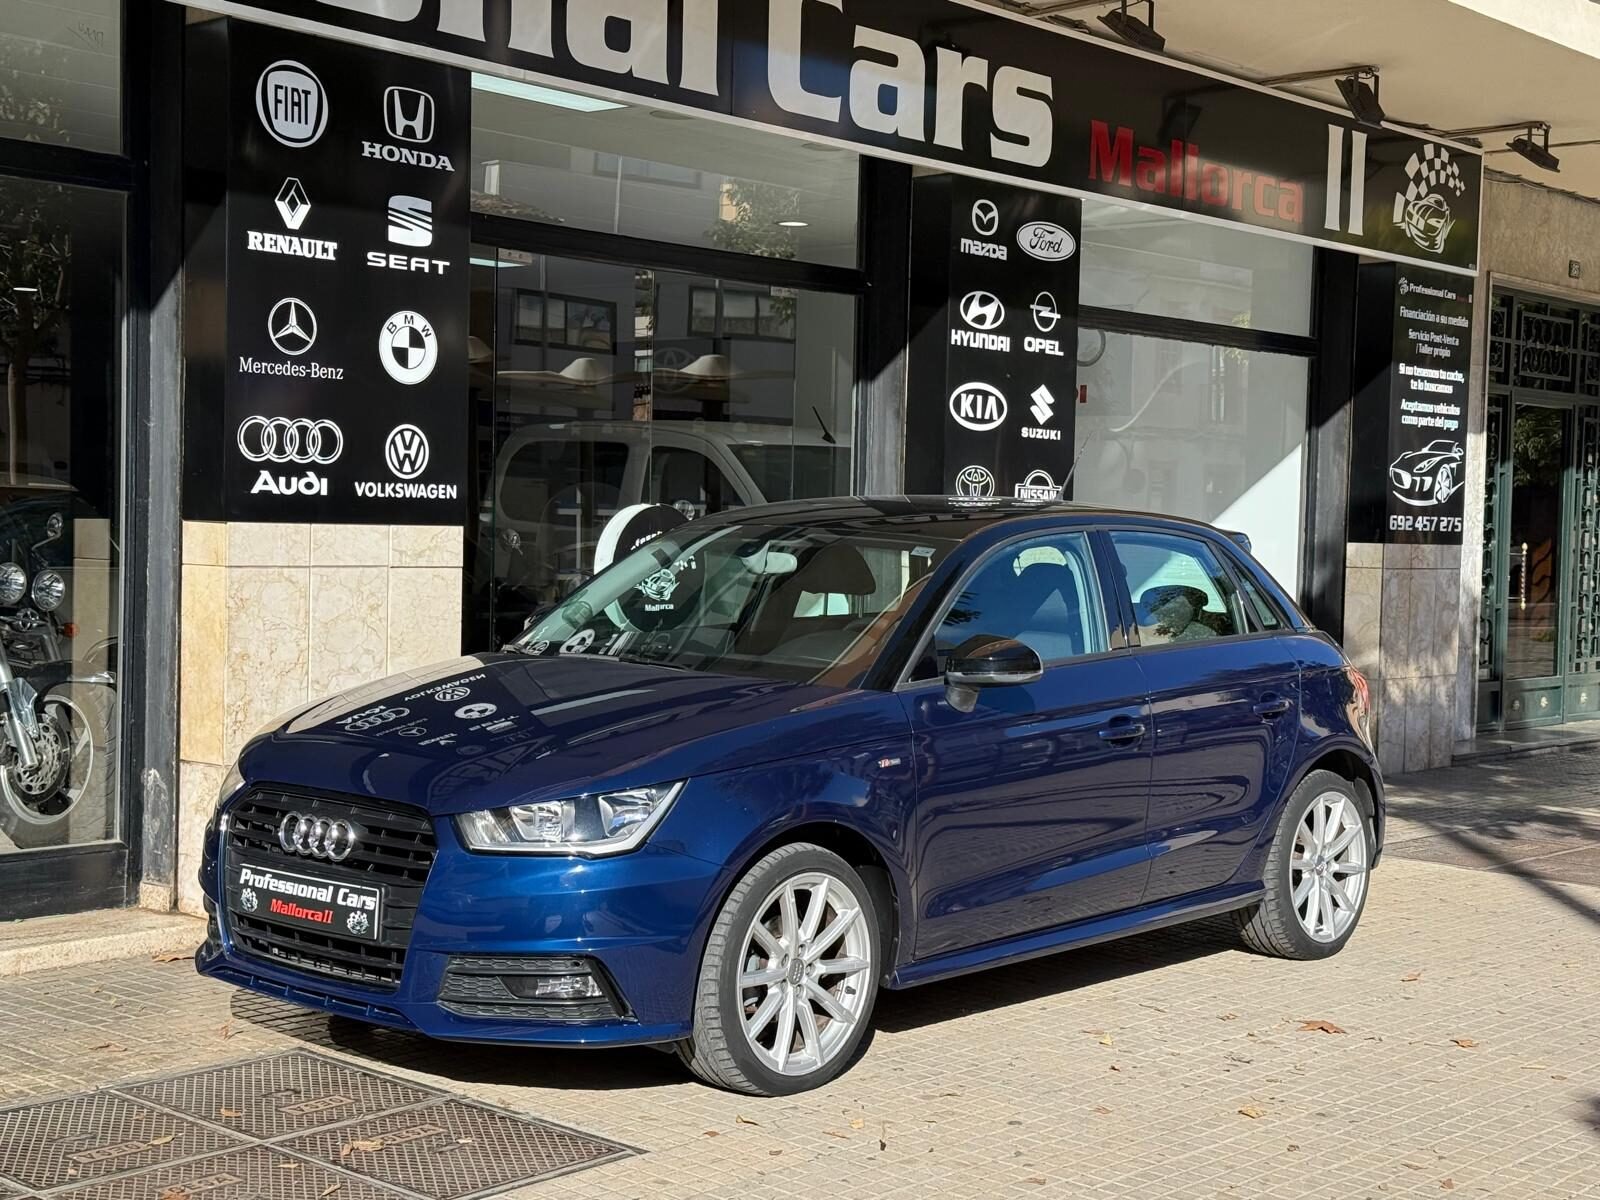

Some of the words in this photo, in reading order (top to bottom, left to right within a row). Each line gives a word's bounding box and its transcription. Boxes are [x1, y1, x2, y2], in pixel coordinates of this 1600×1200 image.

[313, 0, 721, 97] nal
[768, 0, 1055, 169] Cars
[273, 83, 311, 126] FIAT
[361, 141, 455, 172] HONDA
[1088, 119, 1304, 223] Mallorca
[247, 230, 338, 261] RENAULT
[1029, 226, 1064, 254] Ford
[367, 251, 450, 275] SEAT
[1409, 283, 1443, 298] Professional
[1444, 290, 1457, 300] Cars
[386, 314, 432, 338] BMW
[1408, 329, 1430, 341] Servicio
[951, 328, 1011, 353] HYUNDAI
[1023, 336, 1065, 357] OPEL
[238, 356, 344, 381] Mercedes-Benz
[960, 393, 999, 421] KIA
[1021, 426, 1061, 441] SUZUKI
[250, 470, 328, 496] Audi
[354, 481, 457, 500] VOLKSWAGEN
[1019, 487, 1058, 500] NISSAN
[1389, 514, 1414, 531] 692
[1414, 515, 1438, 532] 457
[1439, 516, 1462, 532] 275
[239, 867, 334, 903] Professional
[336, 887, 378, 911] Cars
